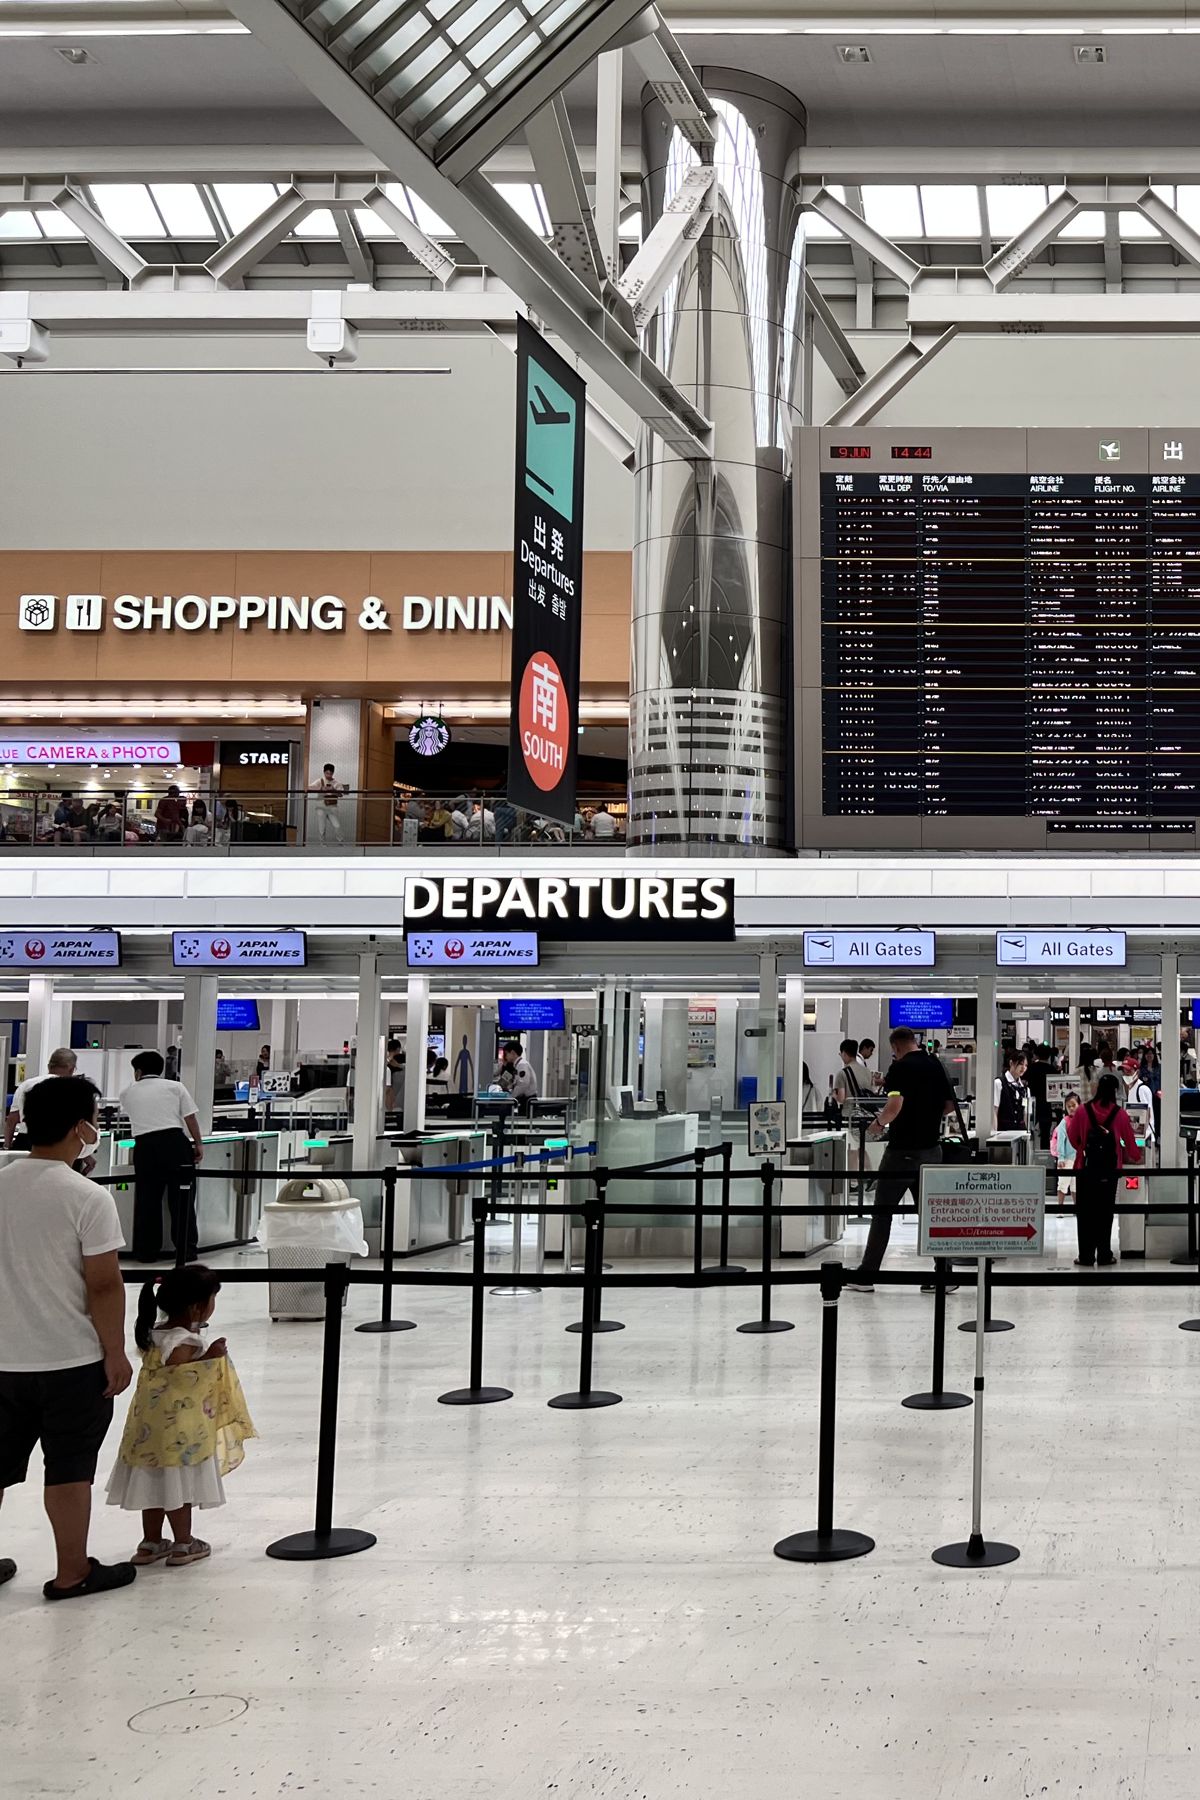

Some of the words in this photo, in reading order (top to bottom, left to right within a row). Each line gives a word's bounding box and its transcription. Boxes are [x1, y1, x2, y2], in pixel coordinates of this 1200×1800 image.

[839, 447, 847, 457] 9
[850, 448, 870, 458] JUN
[836, 484, 853, 492] TIME
[879, 484, 895, 492] WILL
[897, 484, 912, 492] DEP.
[922, 484, 949, 492] TO/VIA
[1030, 484, 1059, 492] AIRLINE
[1094, 484, 1120, 492] FLIGHT
[1122, 484, 1135, 492] NO.
[1152, 484, 1181, 492] AIRLINE
[534, 515, 564, 561] 出発
[521, 540, 574, 596] Departures
[529, 578, 546, 607] 出发
[112, 595, 345, 630] SHOPPING
[358, 596, 392, 630] &
[403, 596, 514, 630] DININ
[532, 662, 559, 732] 南
[27, 747, 98, 758] CAMERA
[101, 749, 109, 758] &
[112, 747, 169, 758] PHOTO
[523, 731, 562, 770] SOUTH
[404, 877, 728, 919] DEPARTURES
[849, 942, 869, 956] All
[875, 942, 922, 956] Gates
[1041, 942, 1060, 956] All
[1067, 942, 1113, 956] Gates
[955, 1182, 1012, 1190] Information
[931, 1206, 970, 1214] Entrance
[973, 1206, 981, 1214] of
[985, 1206, 999, 1214] the
[1001, 1206, 1036, 1215] security
[931, 1215, 979, 1224] checkpoint
[981, 1215, 989, 1223] is
